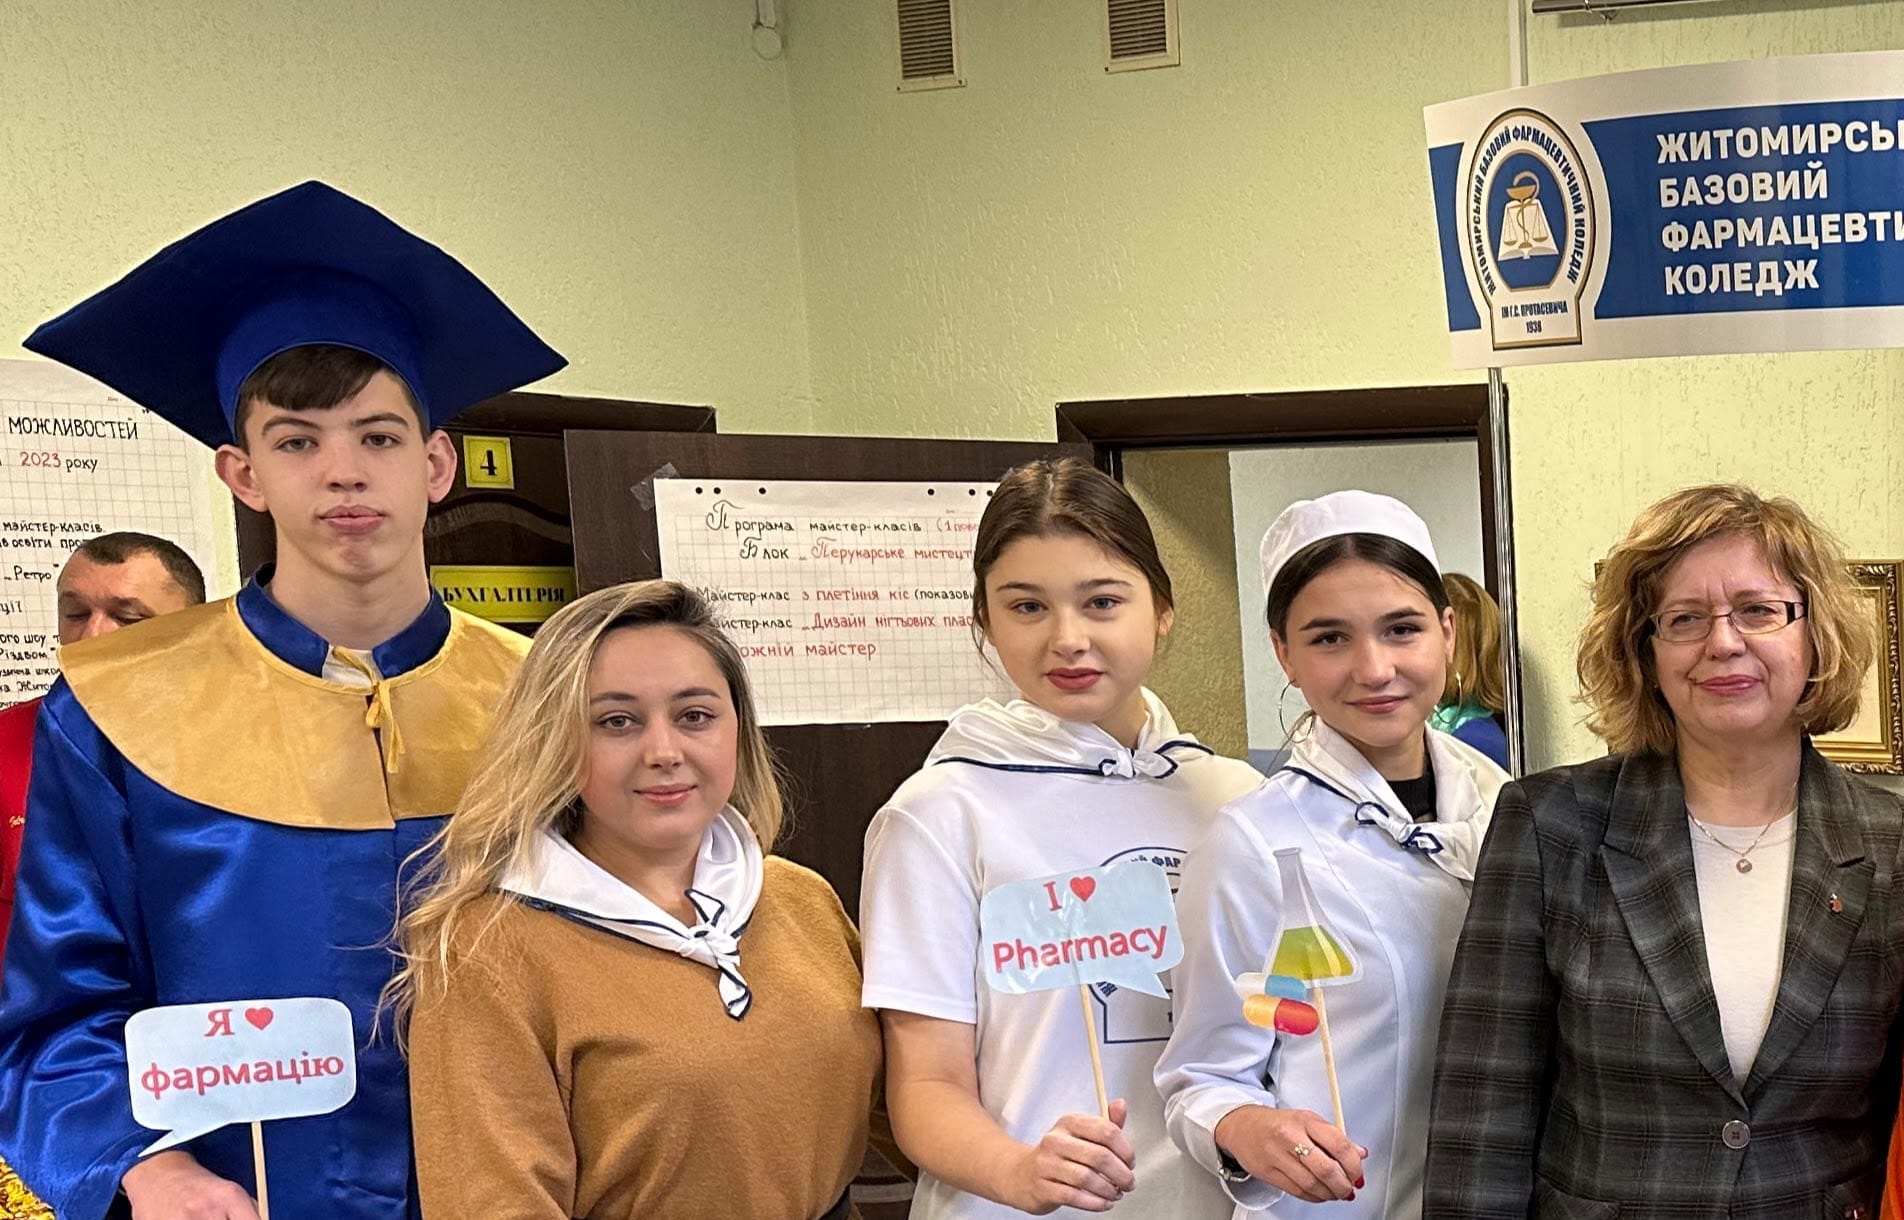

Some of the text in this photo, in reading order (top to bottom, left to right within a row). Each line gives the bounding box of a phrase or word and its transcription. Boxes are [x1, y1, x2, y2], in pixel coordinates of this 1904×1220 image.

[1659, 160, 1829, 208] БАЗОВИЙ
[1473, 125, 1586, 295] ЖИТОМИРСЬКИЙ БАЗОВИЙ ФАРМАЦЕВТИЧНИЙ КОЛЕДЖ
[1664, 259, 1820, 296] КОЛЕДЖ
[20, 451, 98, 473] 2023 року
[480, 450, 497, 476] 4
[706, 500, 795, 537] Програма
[810, 519, 922, 536] майстер-класів
[740, 537, 790, 560] Блок
[816, 588, 879, 601] плетіння
[889, 588, 910, 600] кіс
[806, 641, 877, 661] майстер
[1043, 880, 1063, 912] I
[993, 925, 1168, 973] Pharmacy
[204, 1008, 236, 1037] Я
[141, 1051, 344, 1100] фармацію
